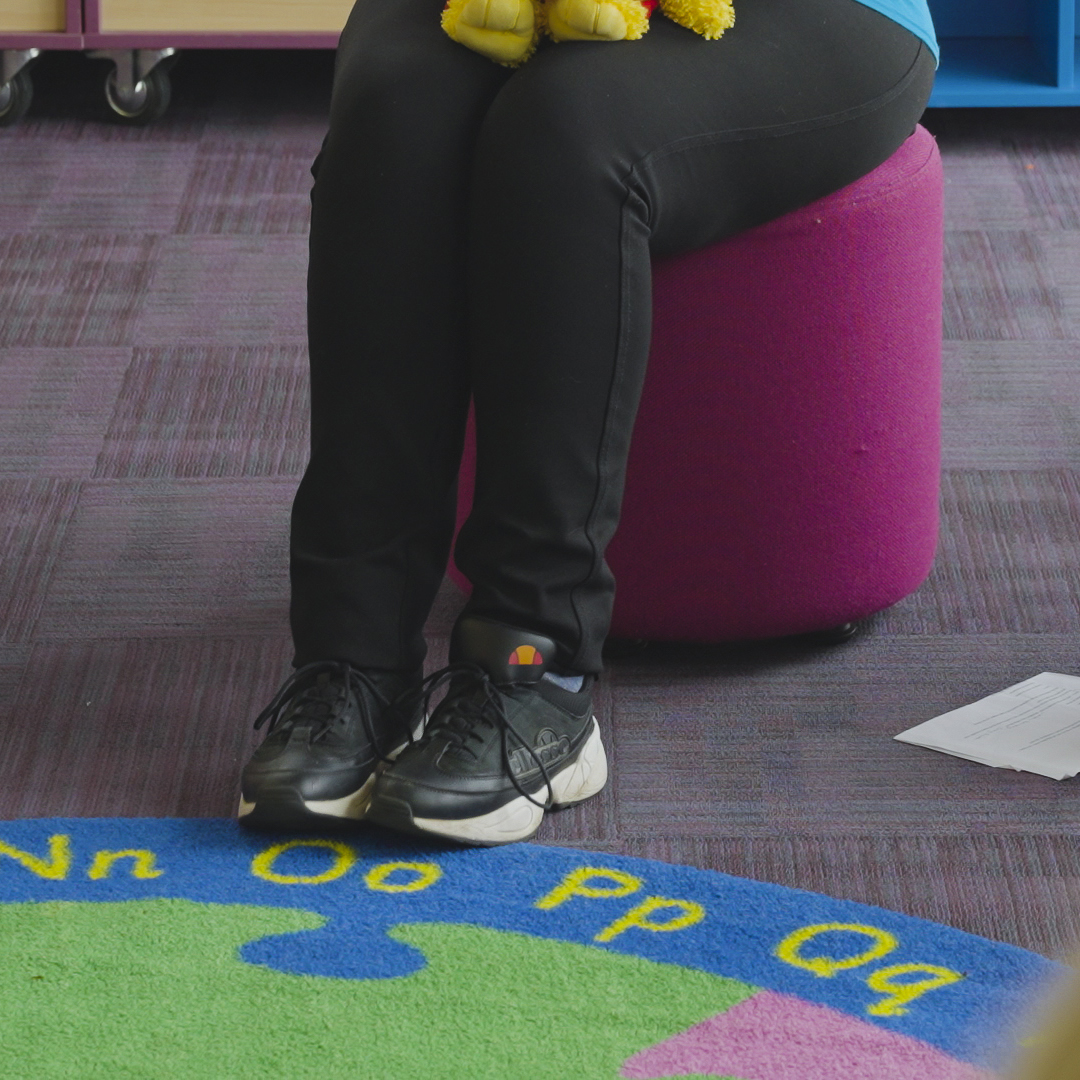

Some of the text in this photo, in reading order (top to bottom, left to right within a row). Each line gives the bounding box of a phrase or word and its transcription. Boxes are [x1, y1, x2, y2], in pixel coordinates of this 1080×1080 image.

[252, 839, 440, 893] Oo
[536, 866, 705, 942] Pp
[775, 923, 963, 1016] Qq
